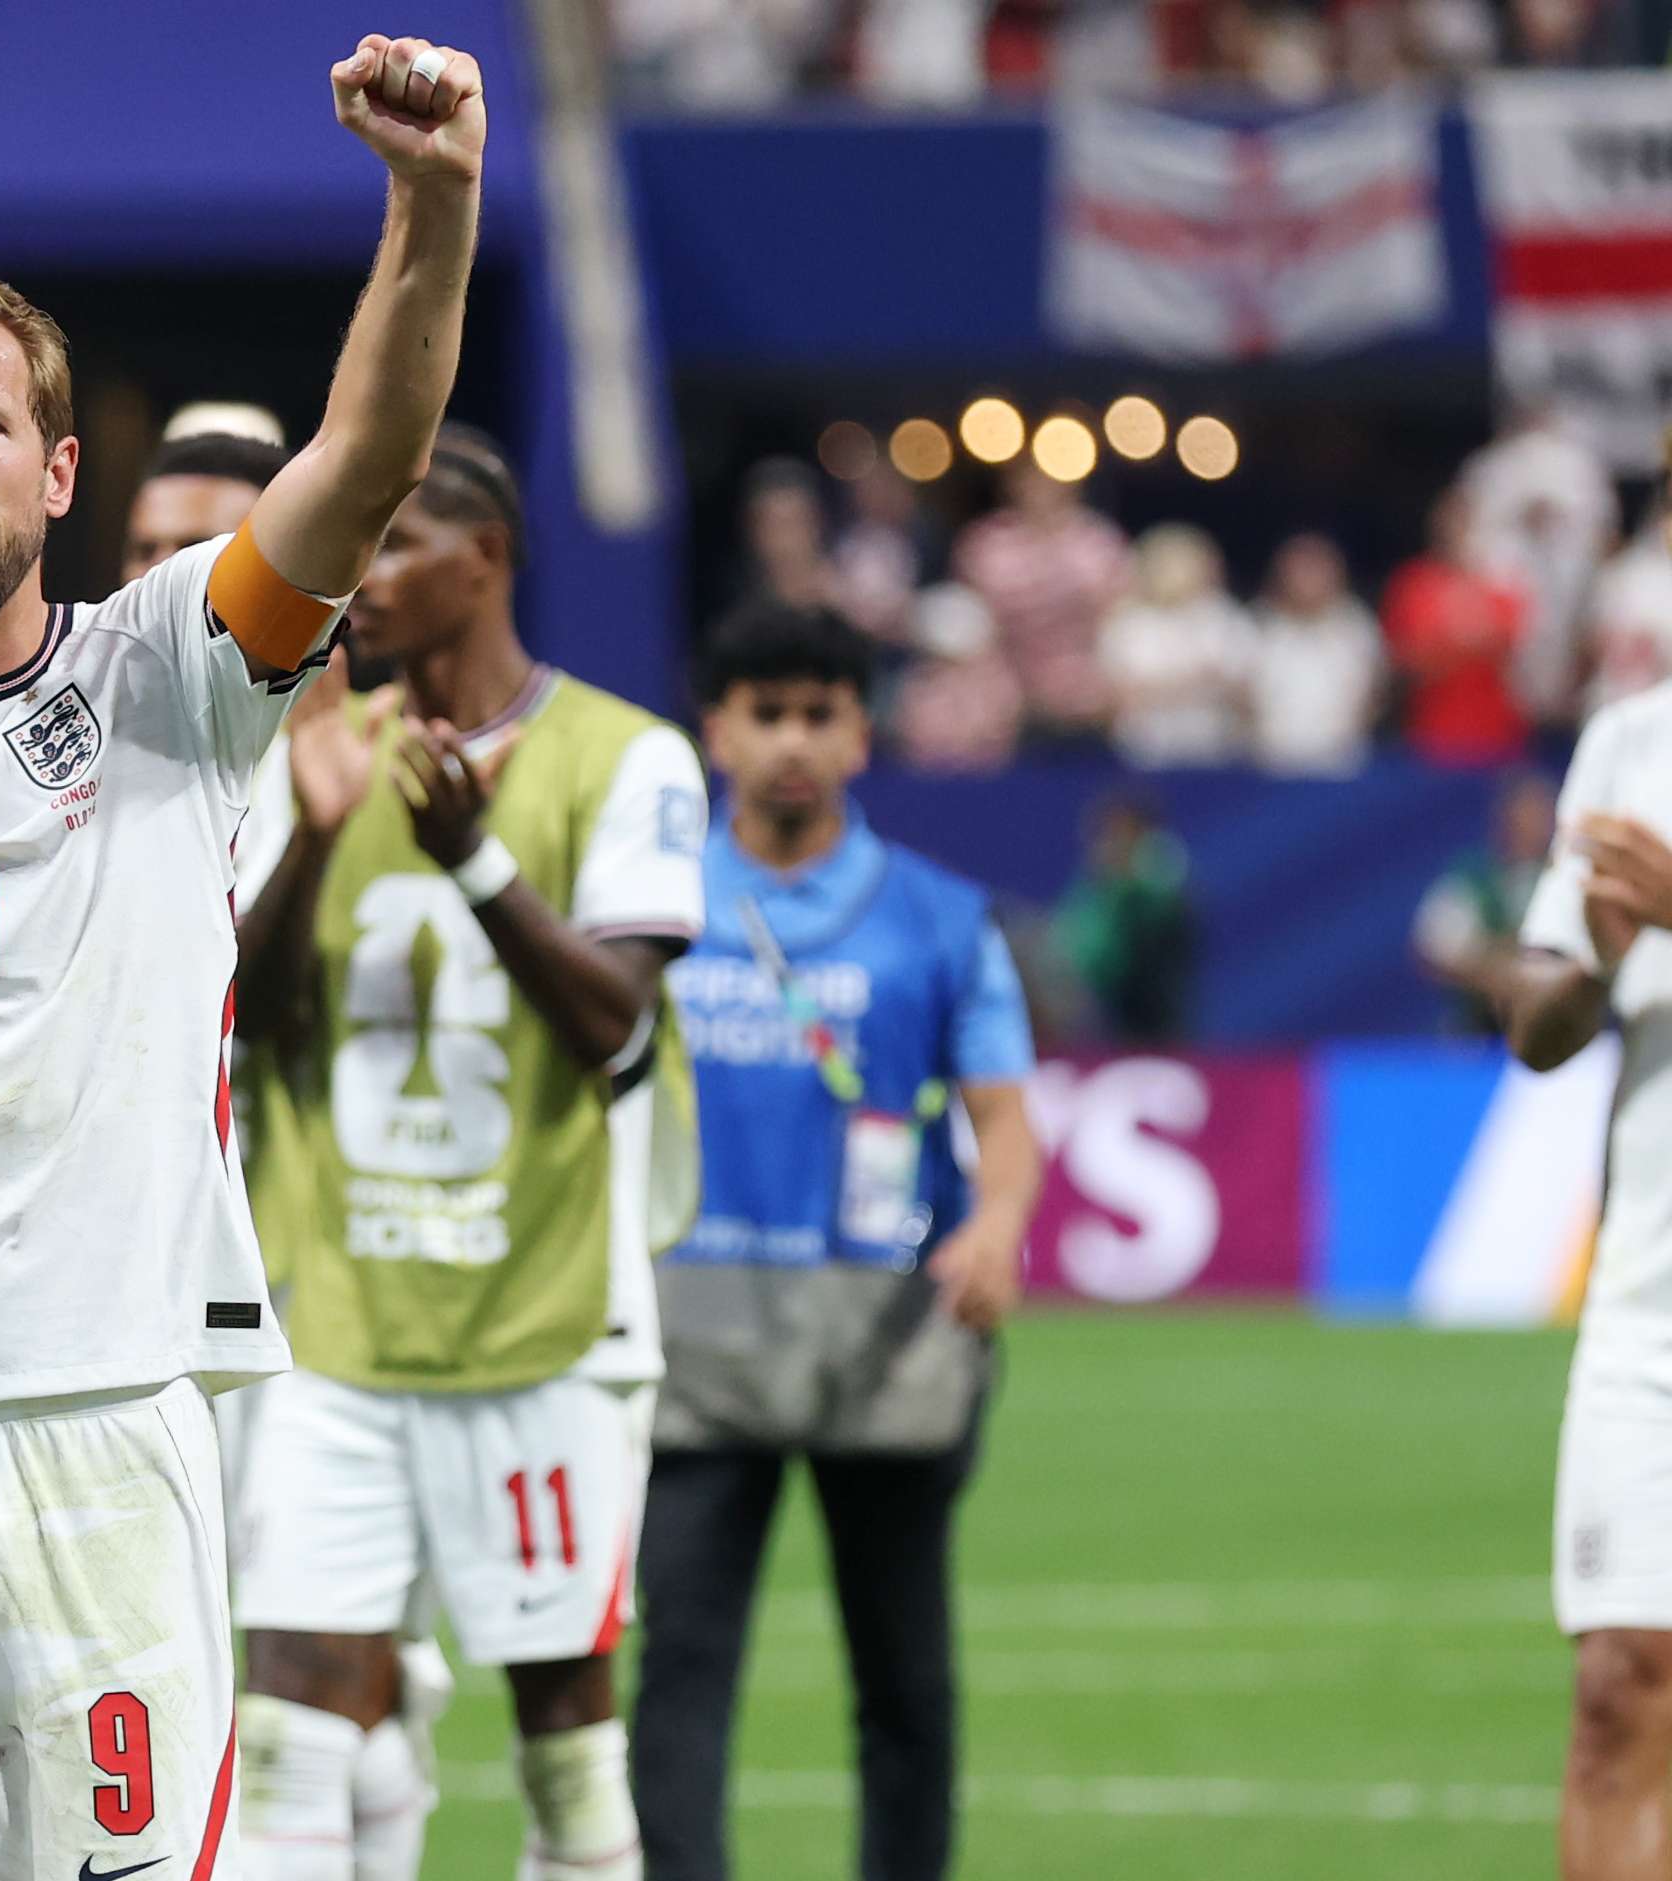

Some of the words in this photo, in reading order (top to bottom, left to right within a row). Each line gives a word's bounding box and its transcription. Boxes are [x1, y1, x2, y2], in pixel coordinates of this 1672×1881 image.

[50, 780, 97, 810] CONGO
[506, 1466, 576, 1568] 11
[88, 1691, 155, 1836] 9
